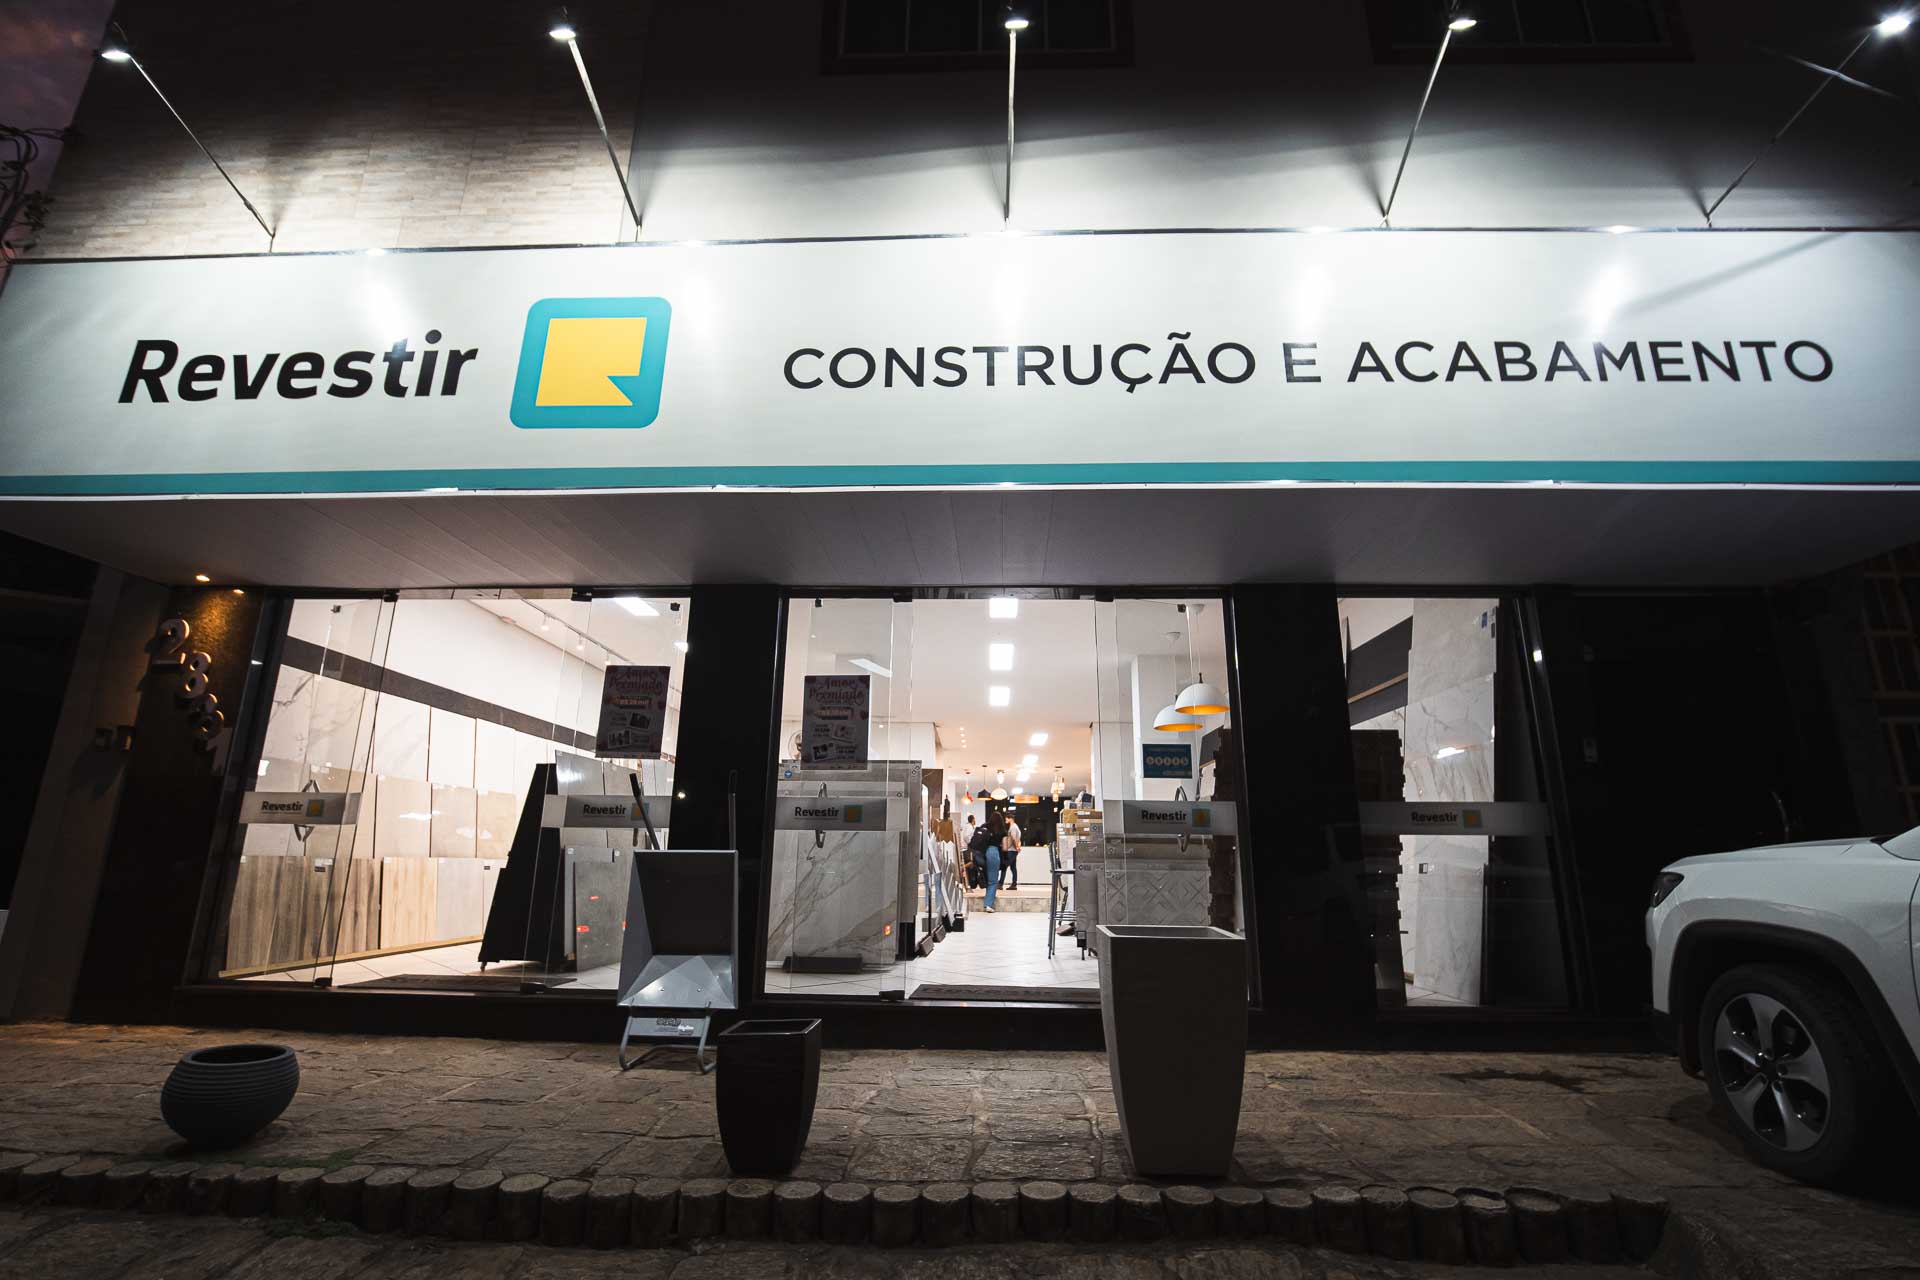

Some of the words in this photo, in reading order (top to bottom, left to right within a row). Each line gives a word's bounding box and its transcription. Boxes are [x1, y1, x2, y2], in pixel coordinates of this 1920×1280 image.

[118, 329, 478, 403] Revestir
[783, 331, 1256, 394] CONSTRUÇÃO
[1282, 342, 1322, 383] E
[1347, 340, 1833, 382] ACABAMENTO
[261, 801, 303, 811] Revestir
[583, 804, 626, 815] Revestir
[794, 806, 840, 817] Revestir
[1141, 810, 1187, 821] Revestir
[1411, 811, 1458, 822] Revestir
